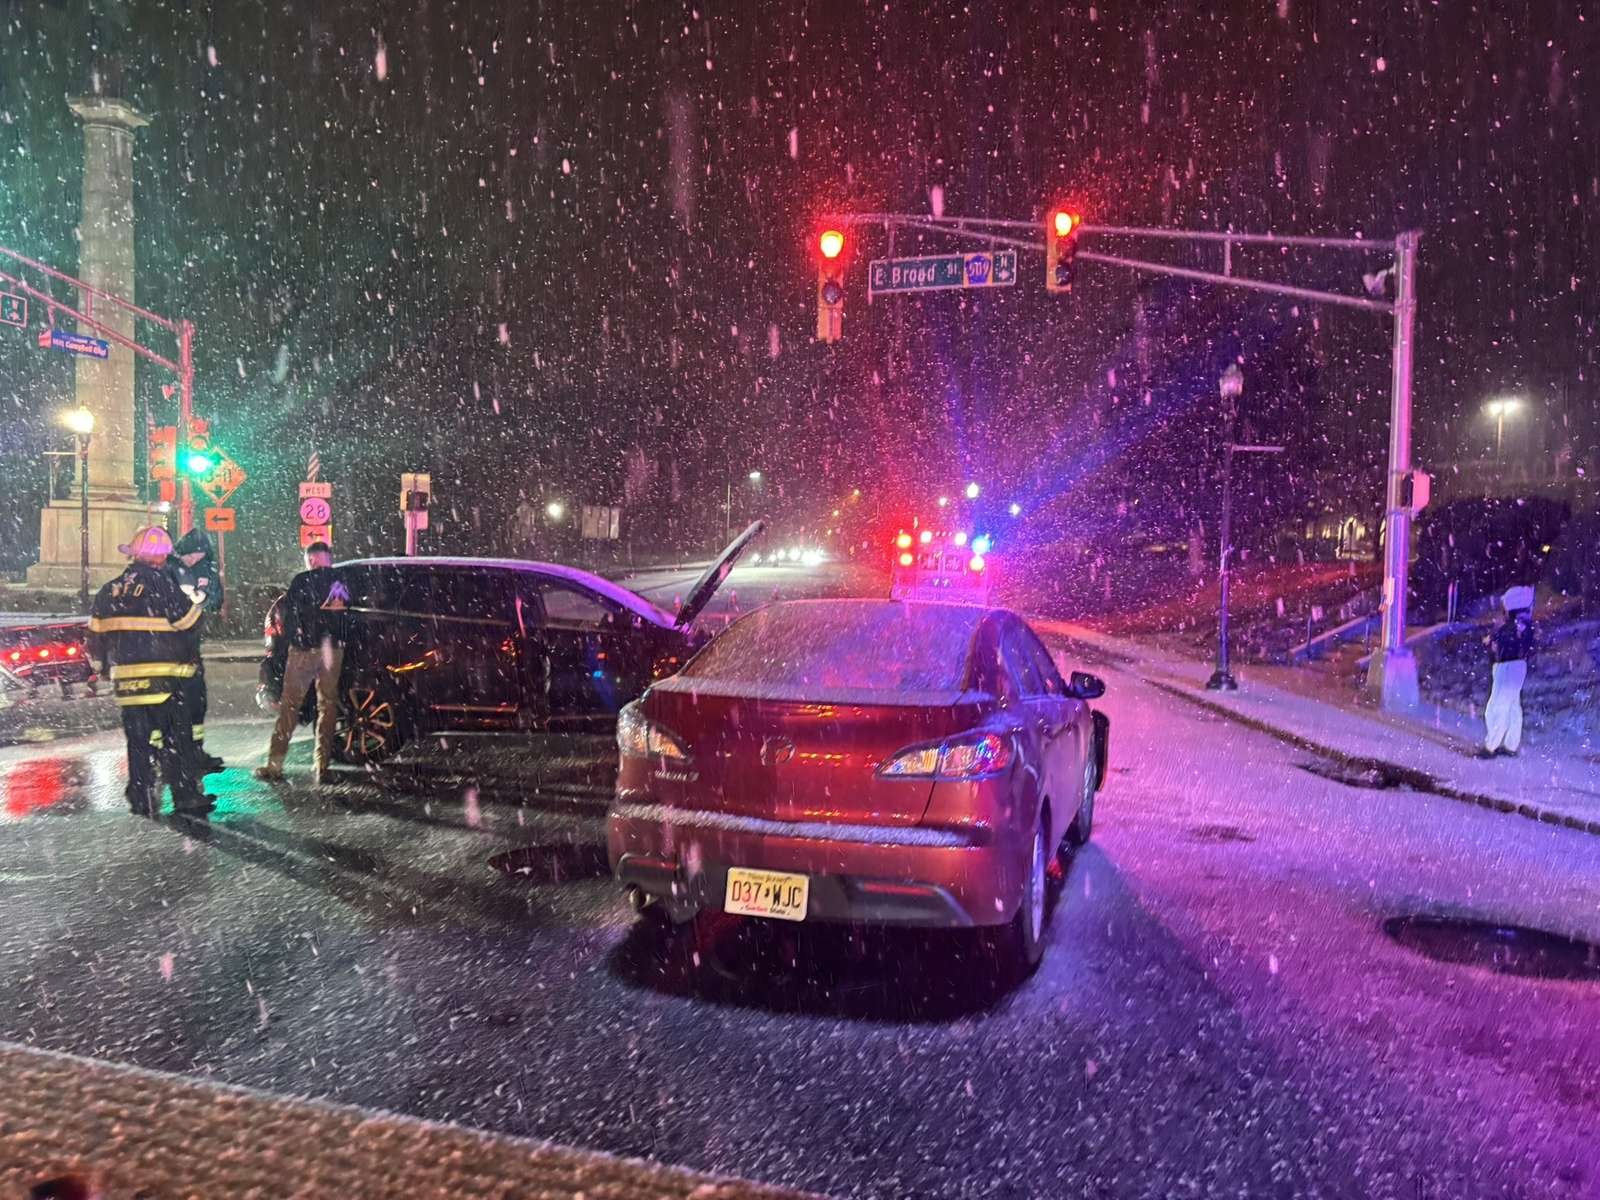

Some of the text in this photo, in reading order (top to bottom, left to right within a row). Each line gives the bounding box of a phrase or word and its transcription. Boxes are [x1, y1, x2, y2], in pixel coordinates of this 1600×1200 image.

[875, 268, 884, 286] E
[891, 263, 937, 285] Broad
[305, 486, 326, 496] WEST
[305, 503, 326, 520] 28
